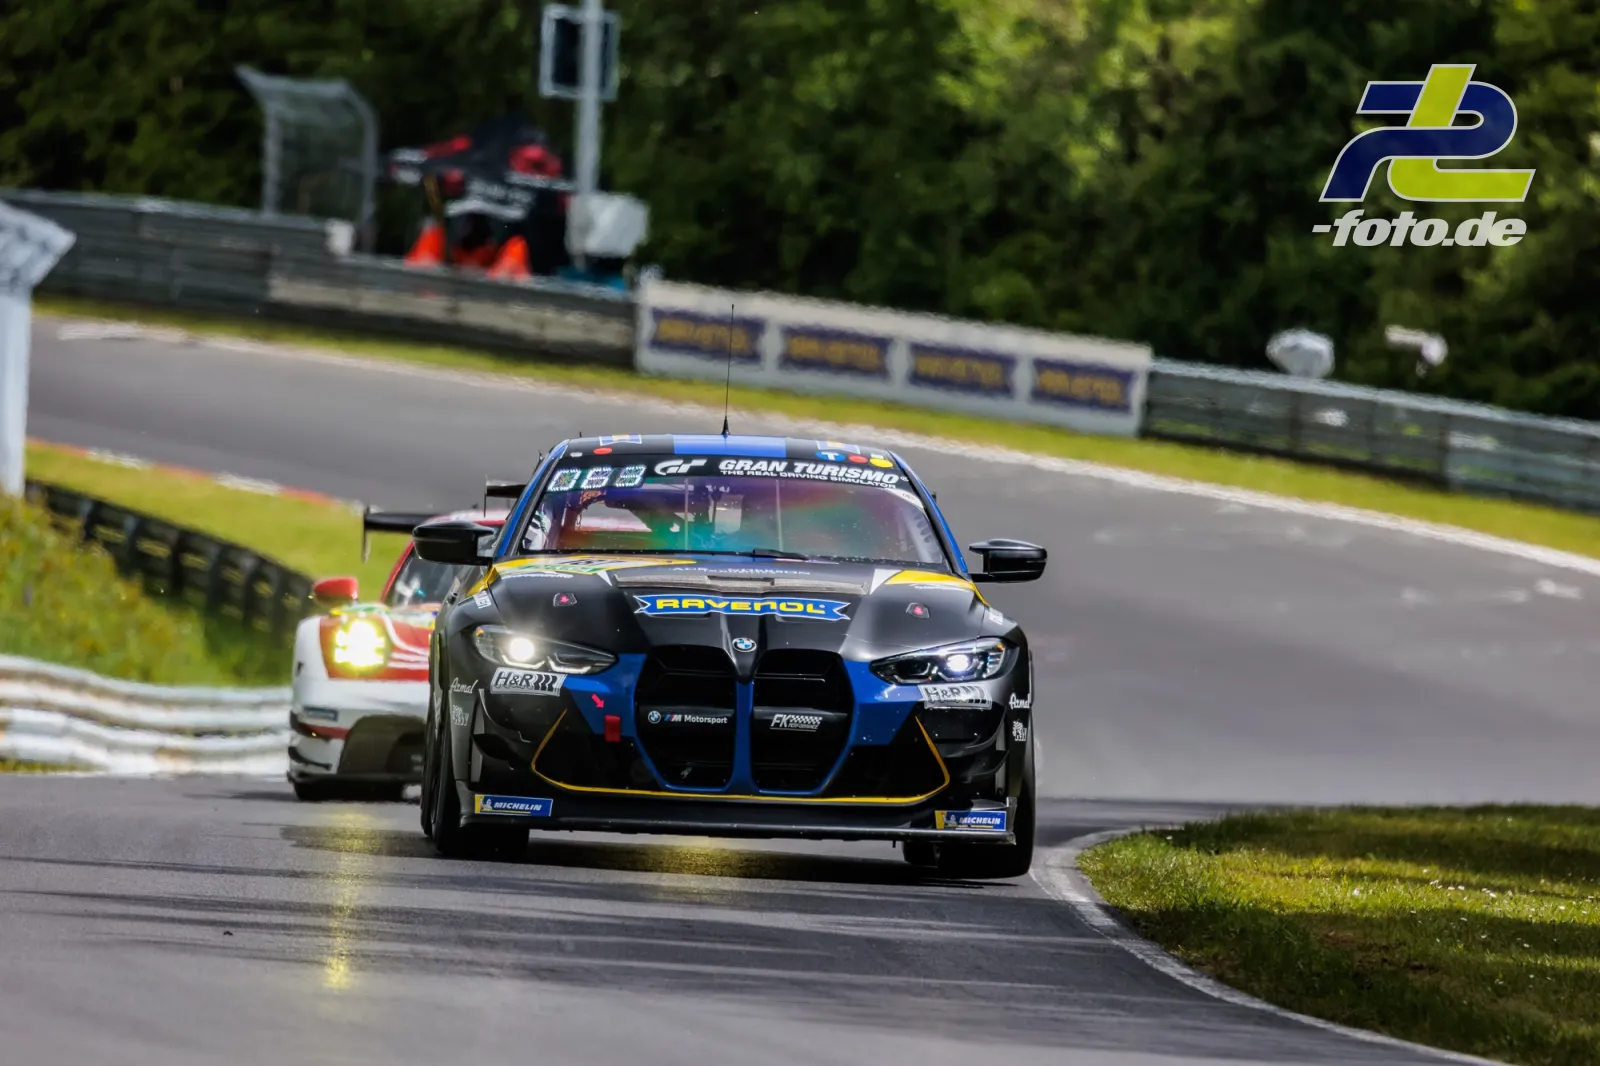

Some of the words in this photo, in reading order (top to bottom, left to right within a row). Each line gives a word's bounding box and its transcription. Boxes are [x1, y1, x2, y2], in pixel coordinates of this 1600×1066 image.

[718, 458, 788, 472] GRAN
[779, 472, 828, 481] DRIVING
[829, 475, 897, 489] SIMULATOR
[656, 598, 826, 615] RAVENOL
[494, 670, 534, 690] H&R
[925, 686, 961, 704] H&R
[684, 714, 728, 725] Motorsport
[770, 713, 791, 728] FK
[493, 801, 543, 811] MICHELIN
[958, 816, 1001, 825] MICHELIN
